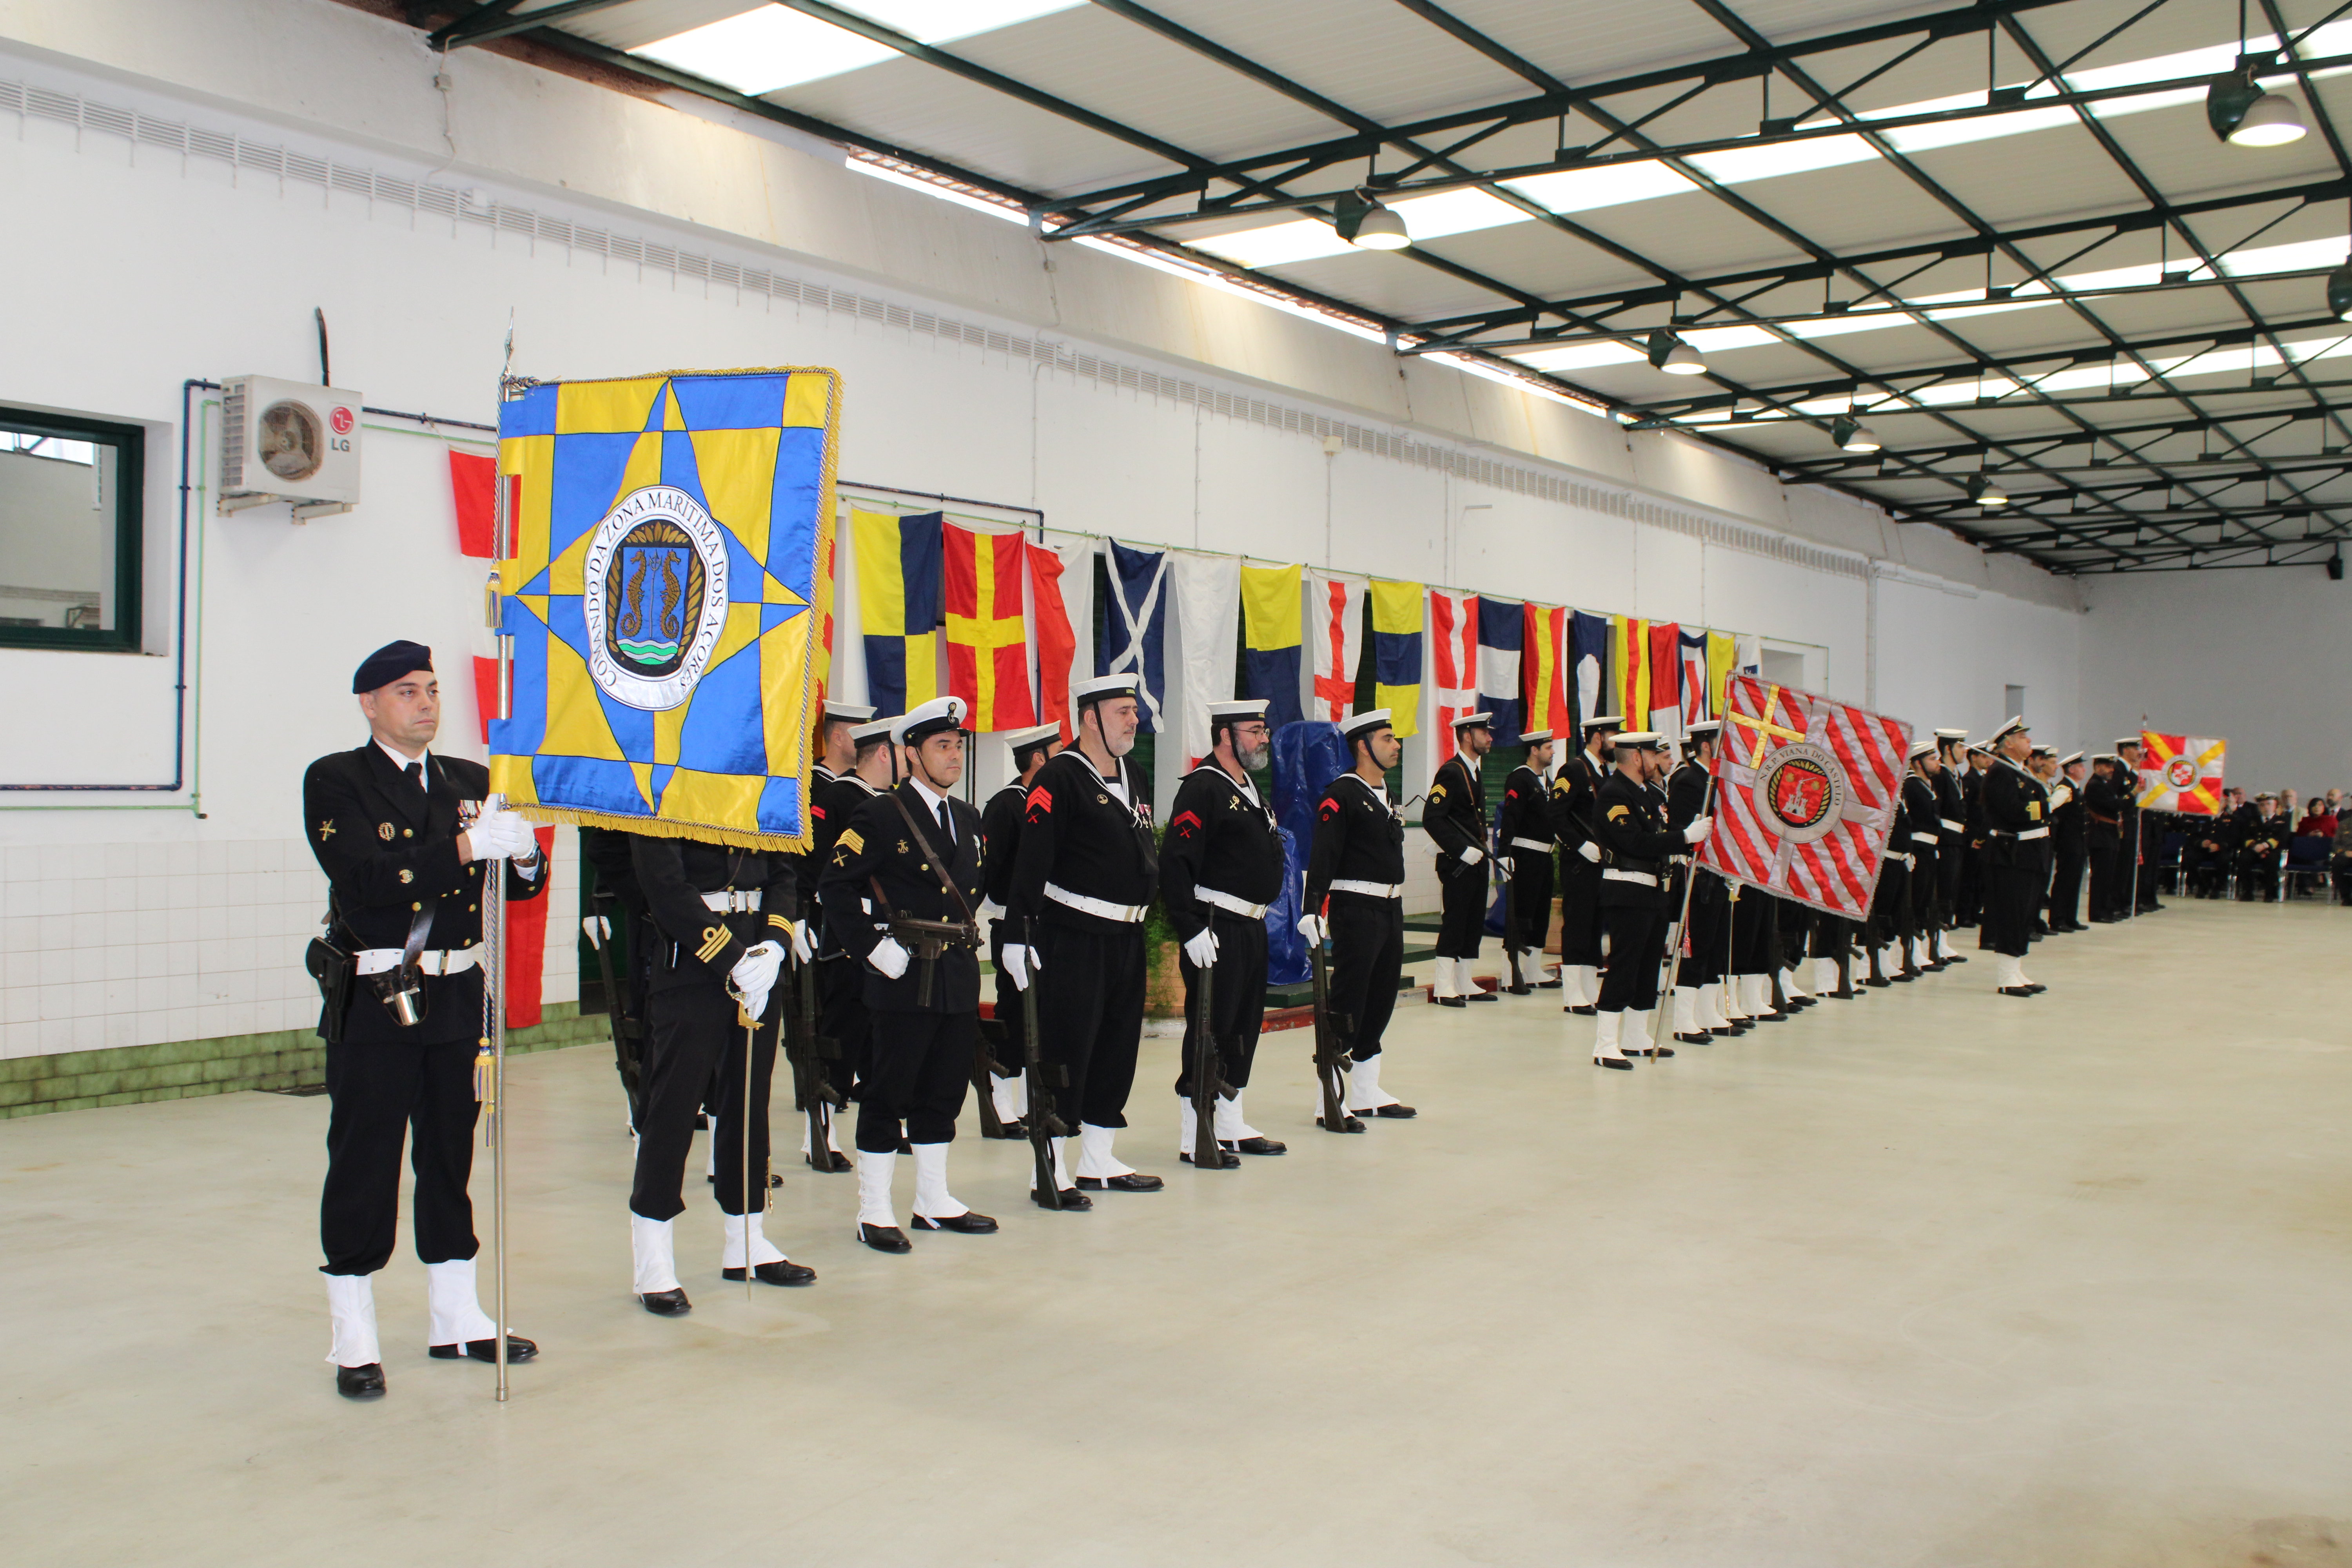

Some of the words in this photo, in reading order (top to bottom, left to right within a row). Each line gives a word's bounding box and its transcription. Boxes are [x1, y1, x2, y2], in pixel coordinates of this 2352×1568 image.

[330, 437, 352, 452] LG
[602, 497, 645, 543] ZONA
[590, 545, 607, 573] DA
[711, 559, 724, 607] DOS
[589, 581, 616, 686] COMANDO
[1779, 747, 1808, 758] VIANA
[1811, 750, 1824, 762] DO
